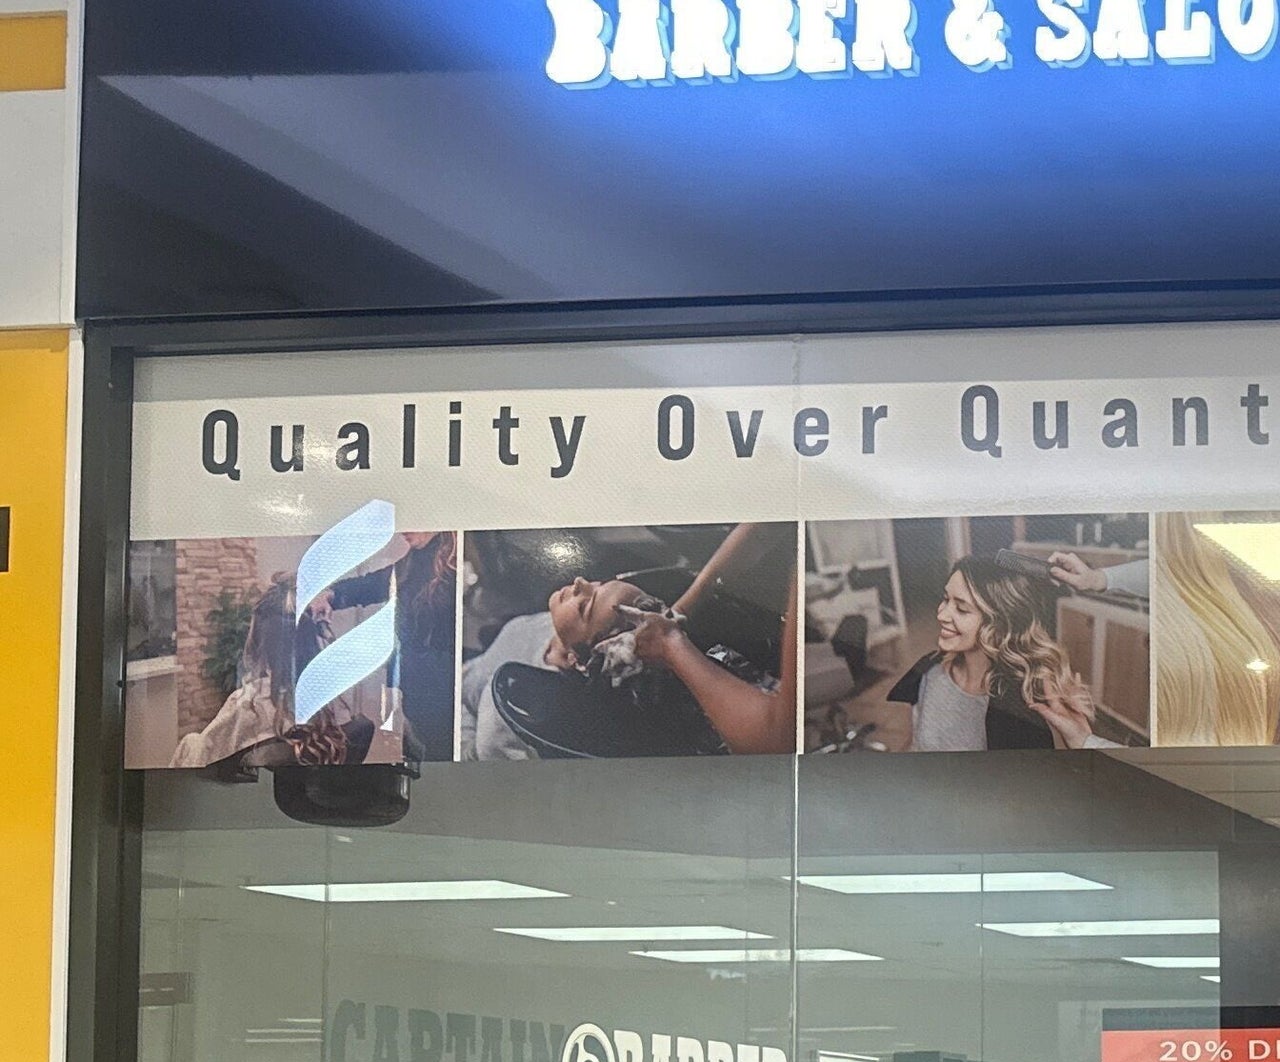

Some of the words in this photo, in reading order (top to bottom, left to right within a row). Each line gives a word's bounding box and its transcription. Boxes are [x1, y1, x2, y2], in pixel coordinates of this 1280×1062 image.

[545, 0, 920, 90] BARBER
[200, 400, 587, 482] Quality
[656, 394, 889, 461] Over
[1159, 1038, 1233, 1062] 20%
